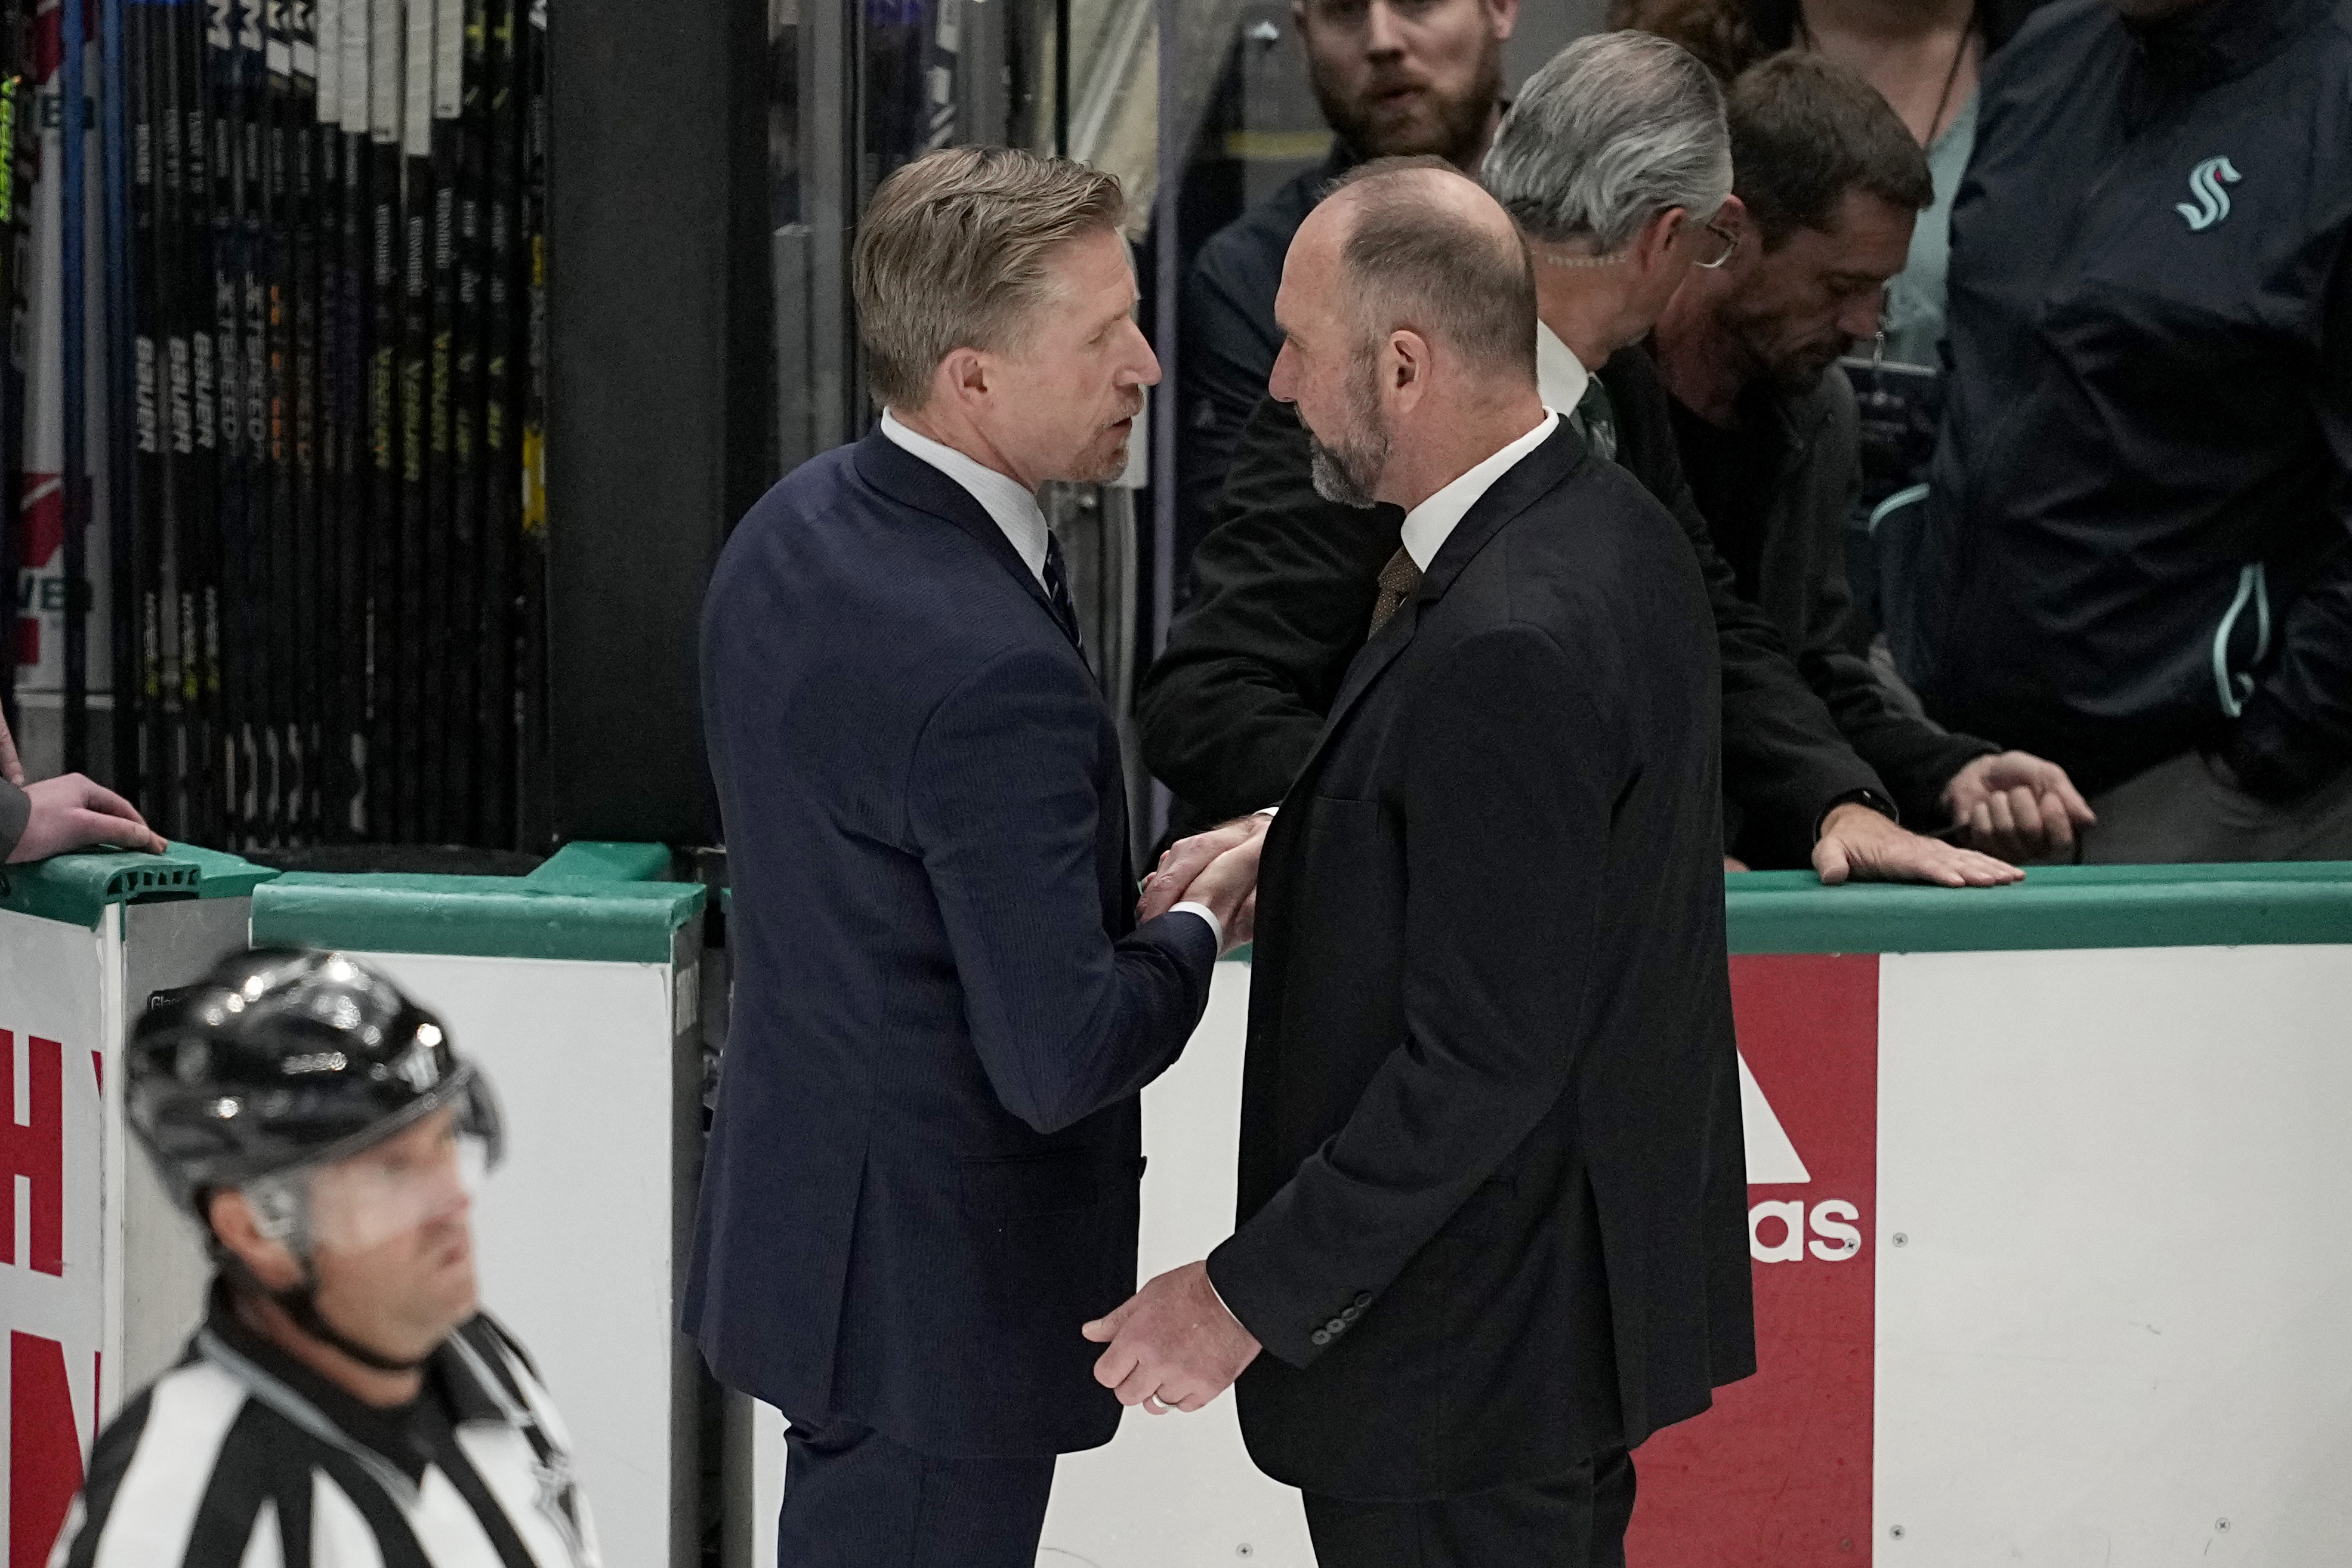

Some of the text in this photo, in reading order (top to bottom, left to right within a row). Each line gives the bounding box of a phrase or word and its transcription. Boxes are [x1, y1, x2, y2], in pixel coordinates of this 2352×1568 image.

[135, 335, 158, 453] BAUER
[169, 336, 193, 453] BAUER
[194, 330, 216, 449] BAUER
